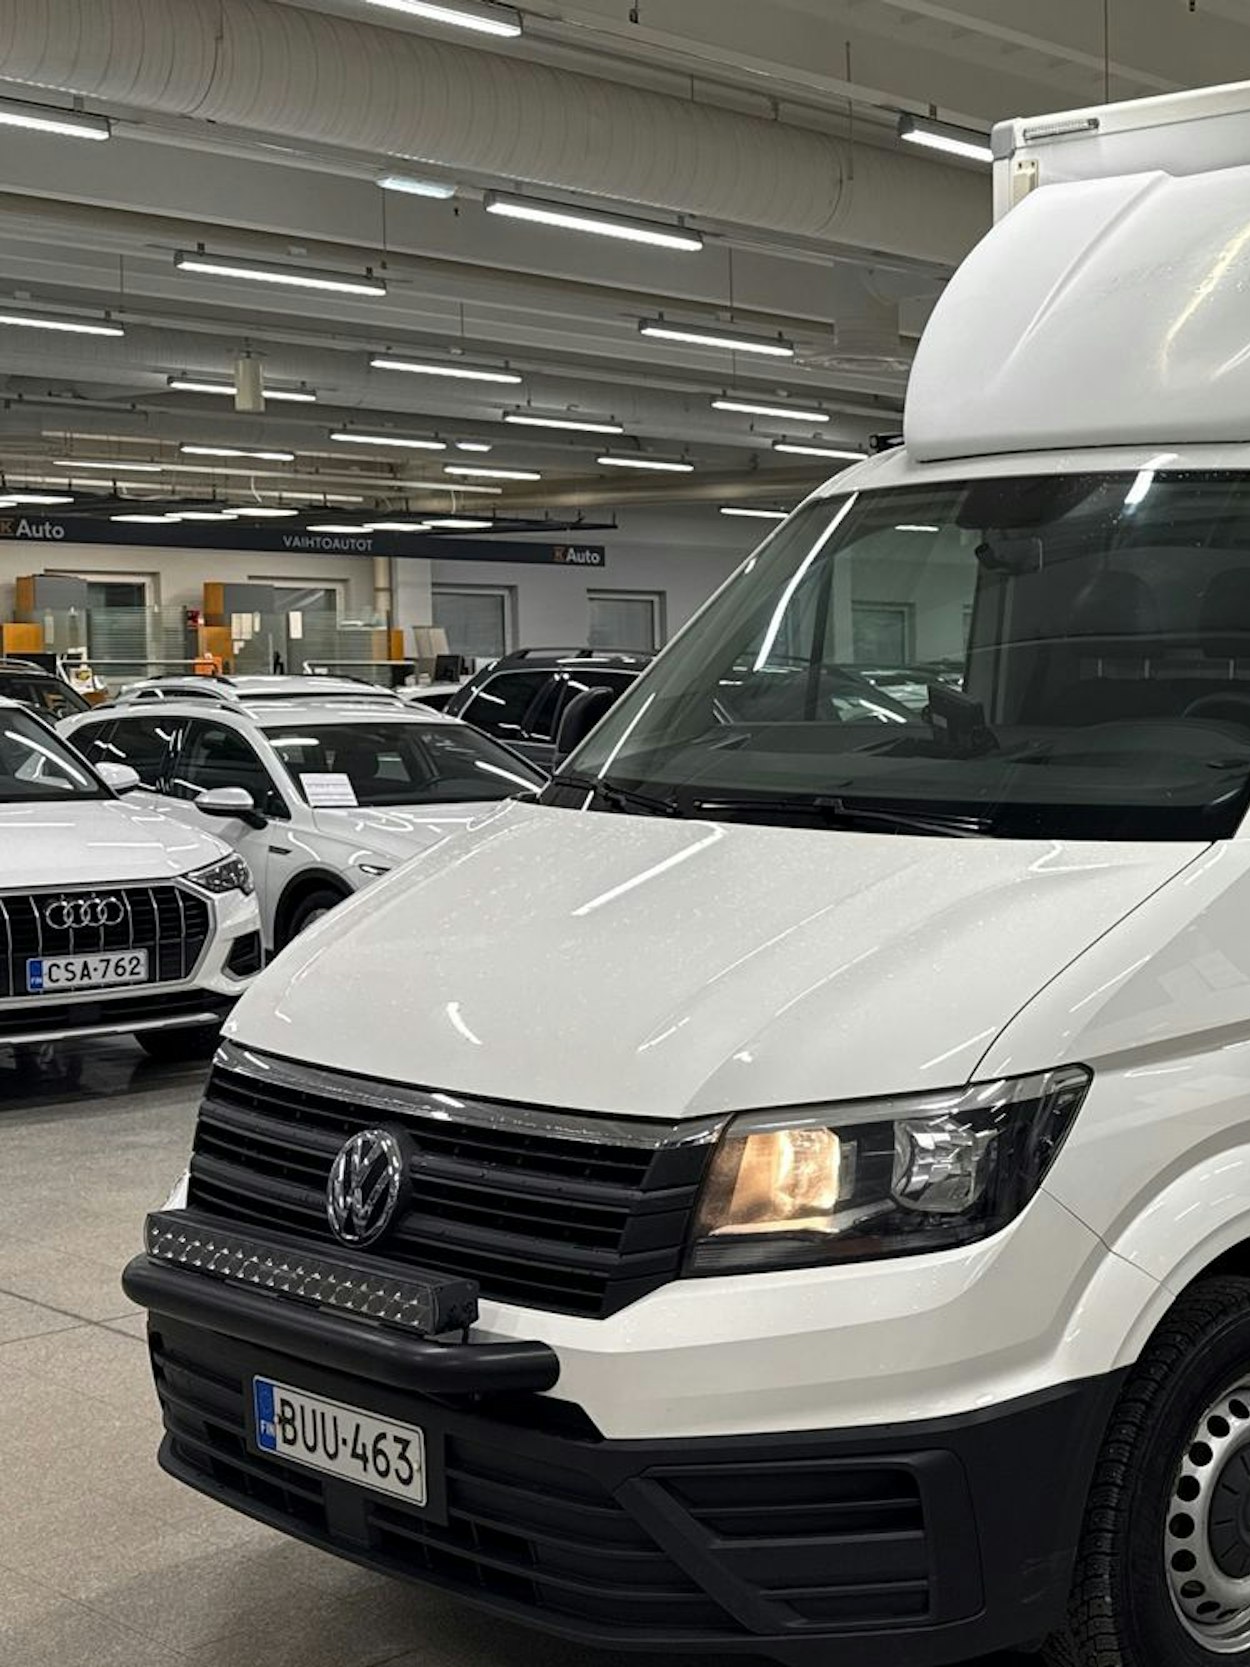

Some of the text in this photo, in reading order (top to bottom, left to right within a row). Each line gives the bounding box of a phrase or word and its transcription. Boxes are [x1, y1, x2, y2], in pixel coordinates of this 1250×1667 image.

[15, 518, 65, 539] Auto
[282, 535, 373, 551] VAIHTOAUTOT
[566, 547, 601, 564] Auto
[48, 956, 141, 983] CSA-762
[279, 1398, 414, 1486] BUU-463
